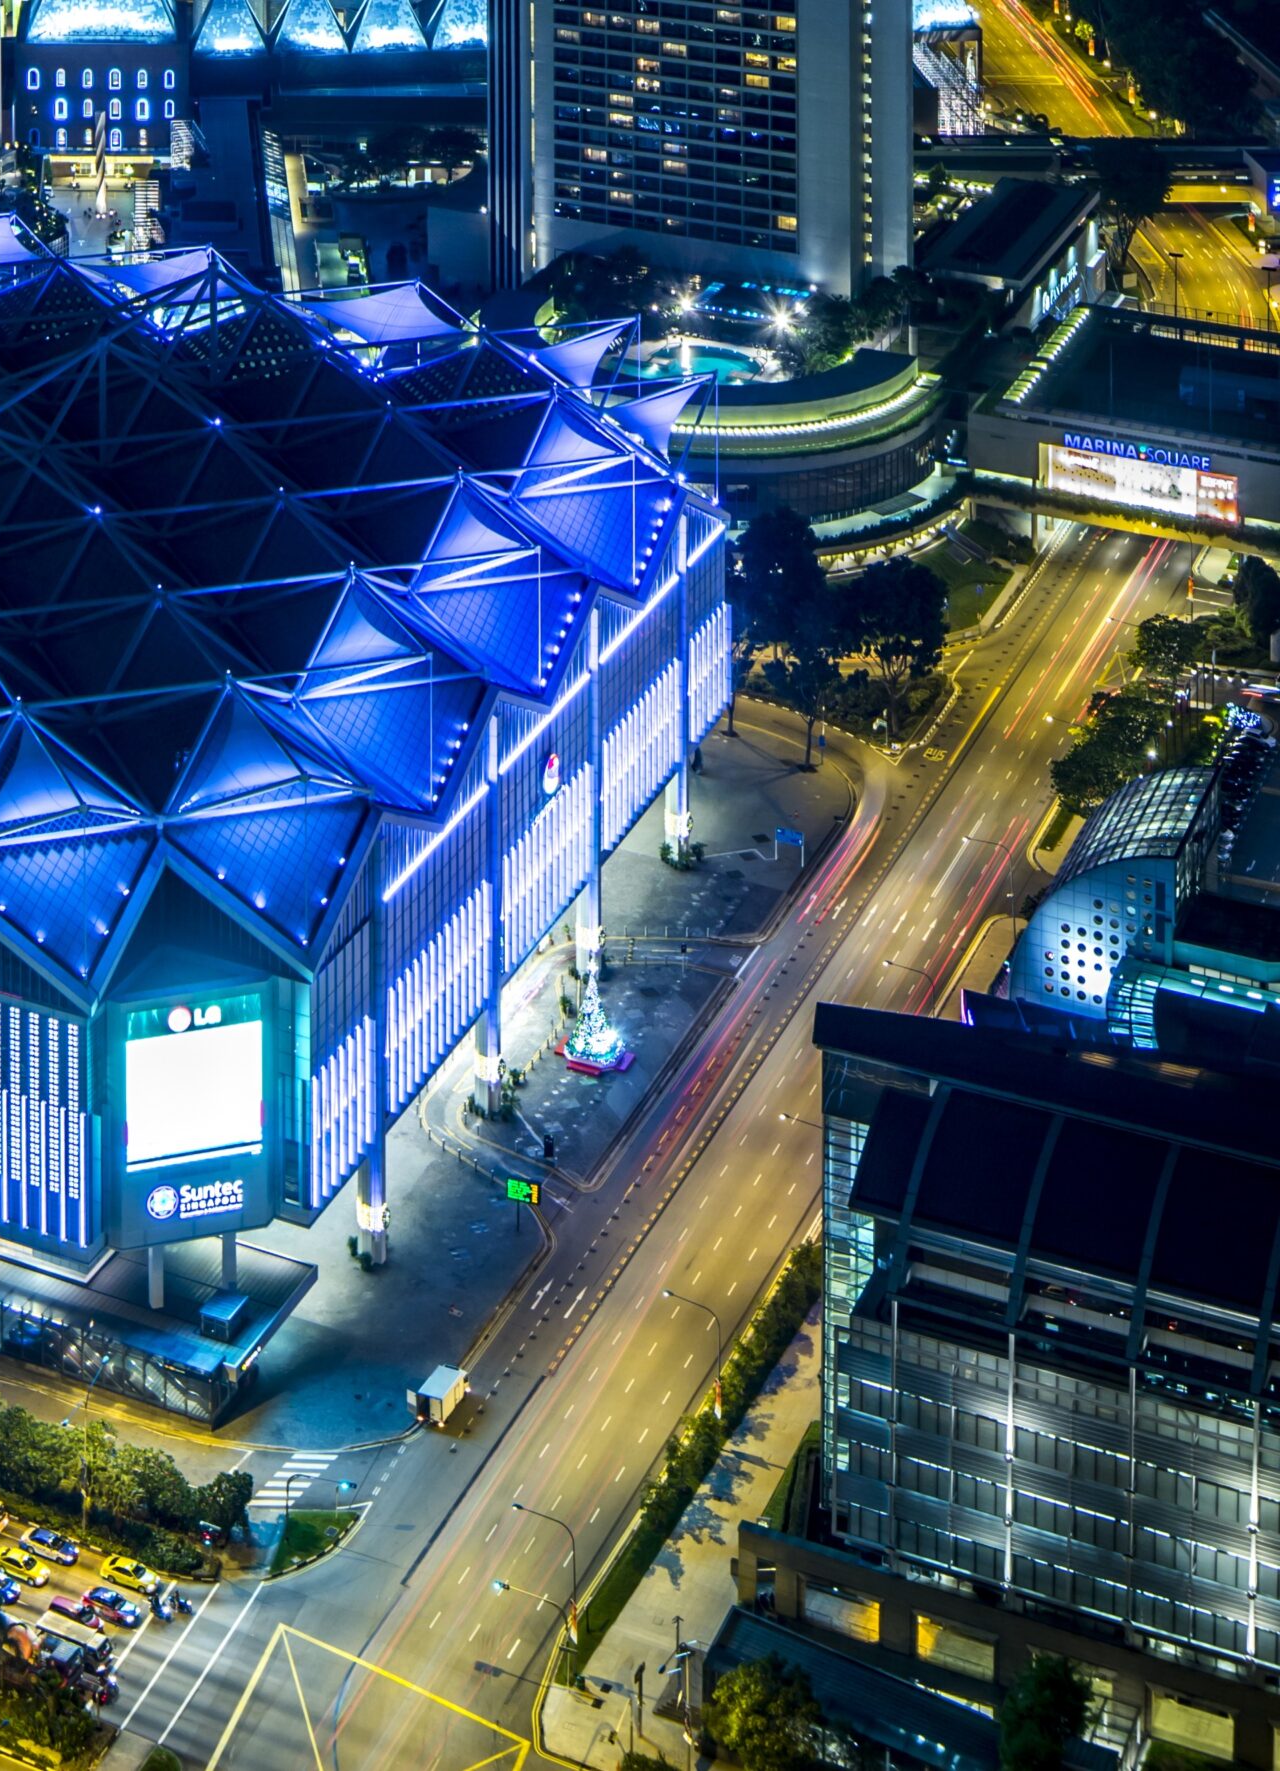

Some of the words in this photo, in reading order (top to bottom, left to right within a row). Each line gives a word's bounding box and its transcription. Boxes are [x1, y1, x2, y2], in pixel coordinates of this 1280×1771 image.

[1063, 433, 1138, 459] MARINA
[1145, 447, 1211, 472] SQUARE
[193, 1005, 222, 1026] LG
[179, 1179, 243, 1203] Suntec
[179, 1193, 243, 1212] SINGAPORE
